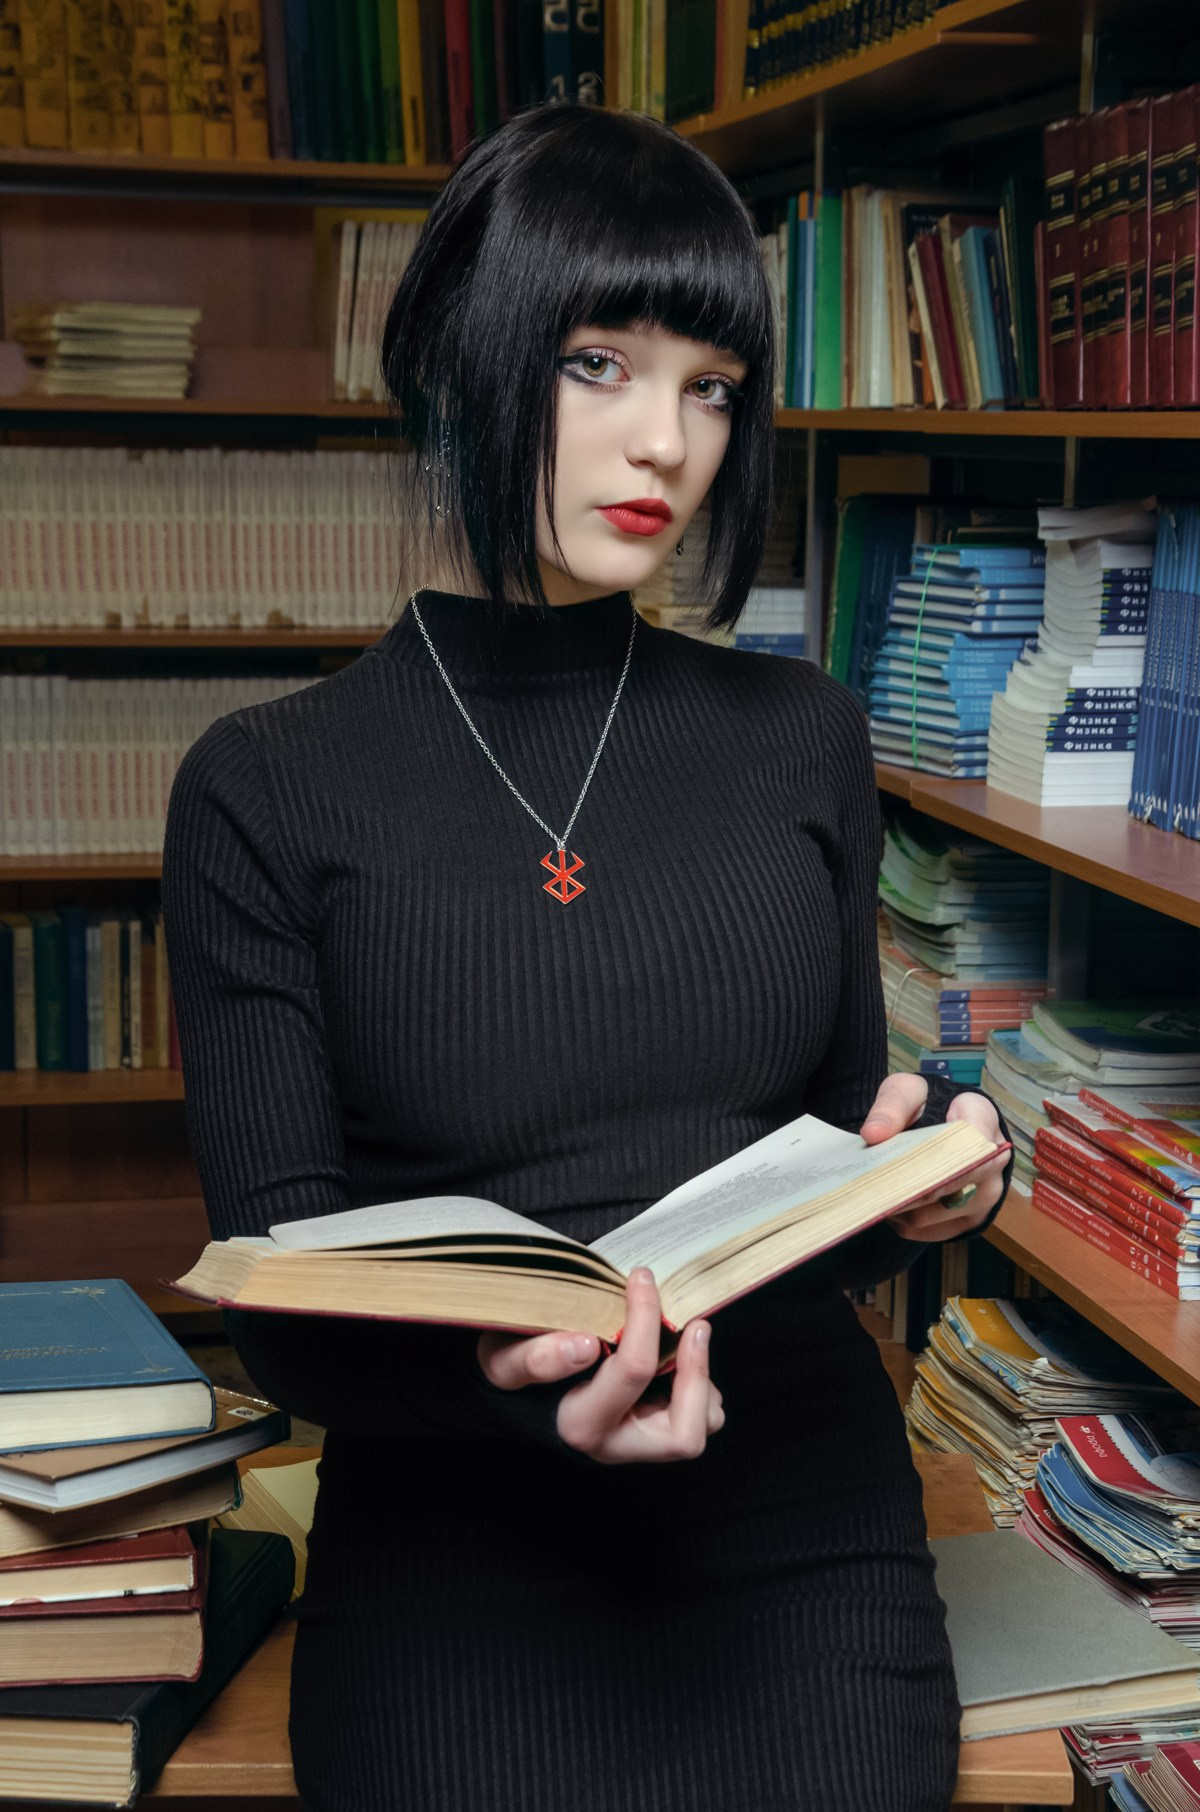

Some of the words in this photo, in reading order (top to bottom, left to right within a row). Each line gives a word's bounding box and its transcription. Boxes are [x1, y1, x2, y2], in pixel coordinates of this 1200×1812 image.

[1087, 688, 1134, 697] Физика
[1084, 701, 1132, 710] Физика
[1069, 716, 1116, 725] Физика
[1066, 726, 1113, 735] Физика
[1064, 741, 1112, 750] Физика
